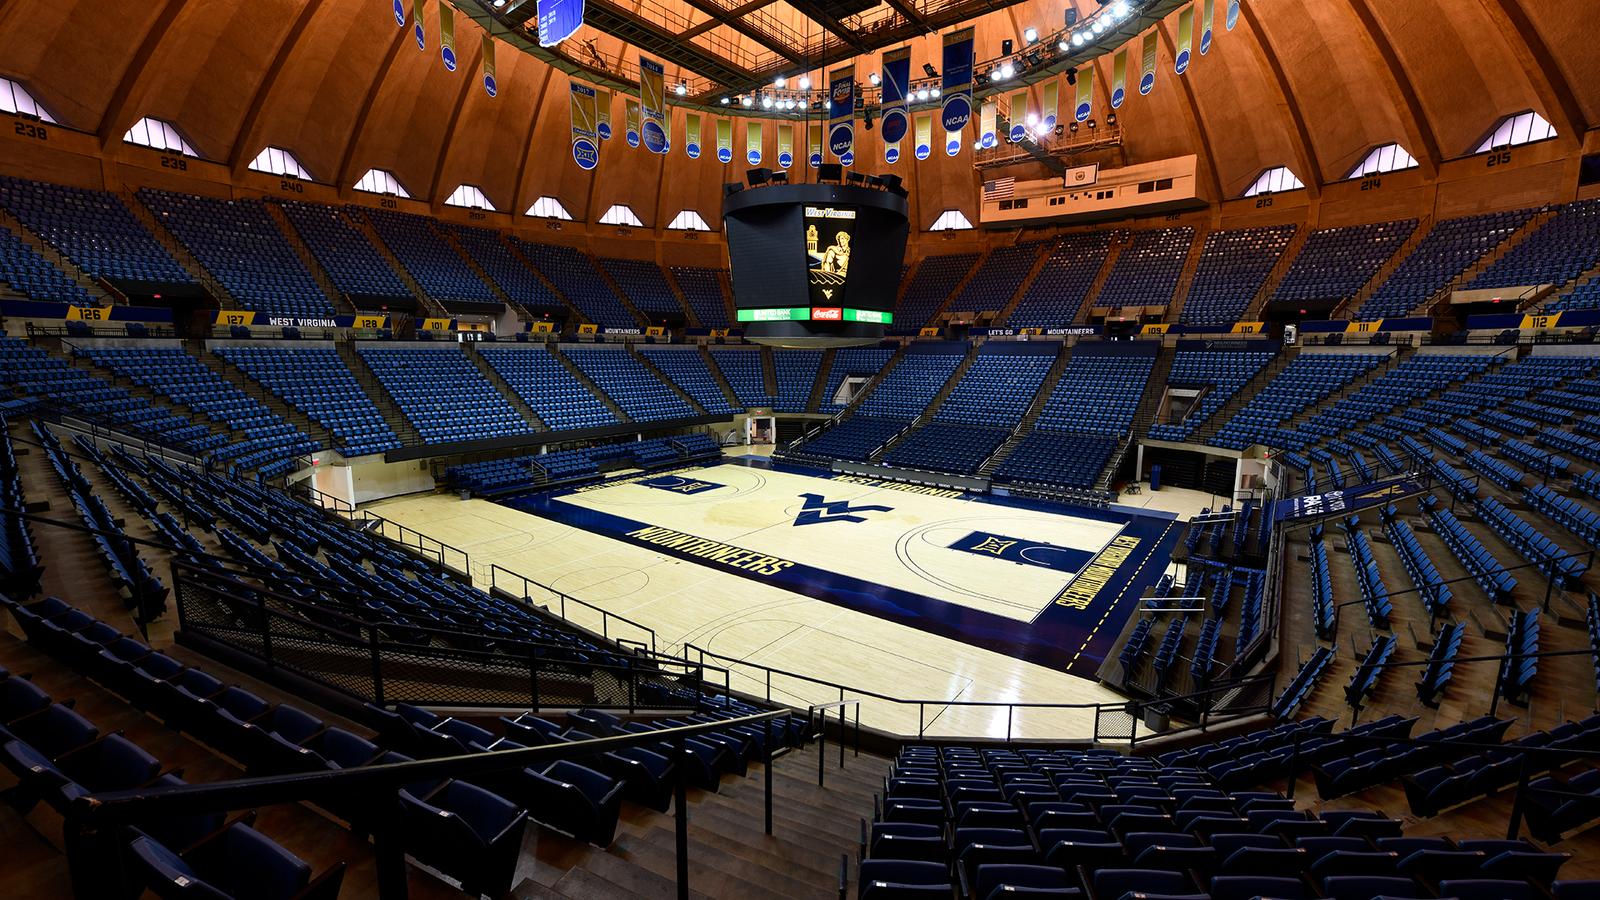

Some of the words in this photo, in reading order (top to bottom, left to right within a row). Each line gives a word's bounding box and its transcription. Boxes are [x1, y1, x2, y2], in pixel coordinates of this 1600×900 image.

[945, 114, 969, 126] NCAA
[14, 121, 48, 140] 238
[833, 140, 852, 151] NCAA
[160, 156, 188, 171] 239
[1486, 152, 1512, 167] 215
[281, 180, 303, 194] 240
[1360, 177, 1381, 191] 214
[380, 199, 398, 209] 201
[1255, 198, 1273, 209] 213
[79, 308, 101, 320] 126
[227, 315, 244, 325] 127
[269, 317, 294, 326] WEST
[299, 318, 337, 328] VIRGINIA
[361, 319, 377, 328] 128
[431, 321, 443, 330] 101
[1532, 317, 1548, 328] 112
[583, 326, 593, 334] 102
[604, 327, 641, 335] MOUNTAINEERS
[1047, 328, 1094, 336] MOUNTAINEERS
[1148, 327, 1162, 335] 109
[1241, 325, 1253, 333] 110
[1358, 323, 1369, 332] 111
[877, 480, 964, 499] VIRGINIA
[625, 525, 795, 576] MOUNTAINEERS
